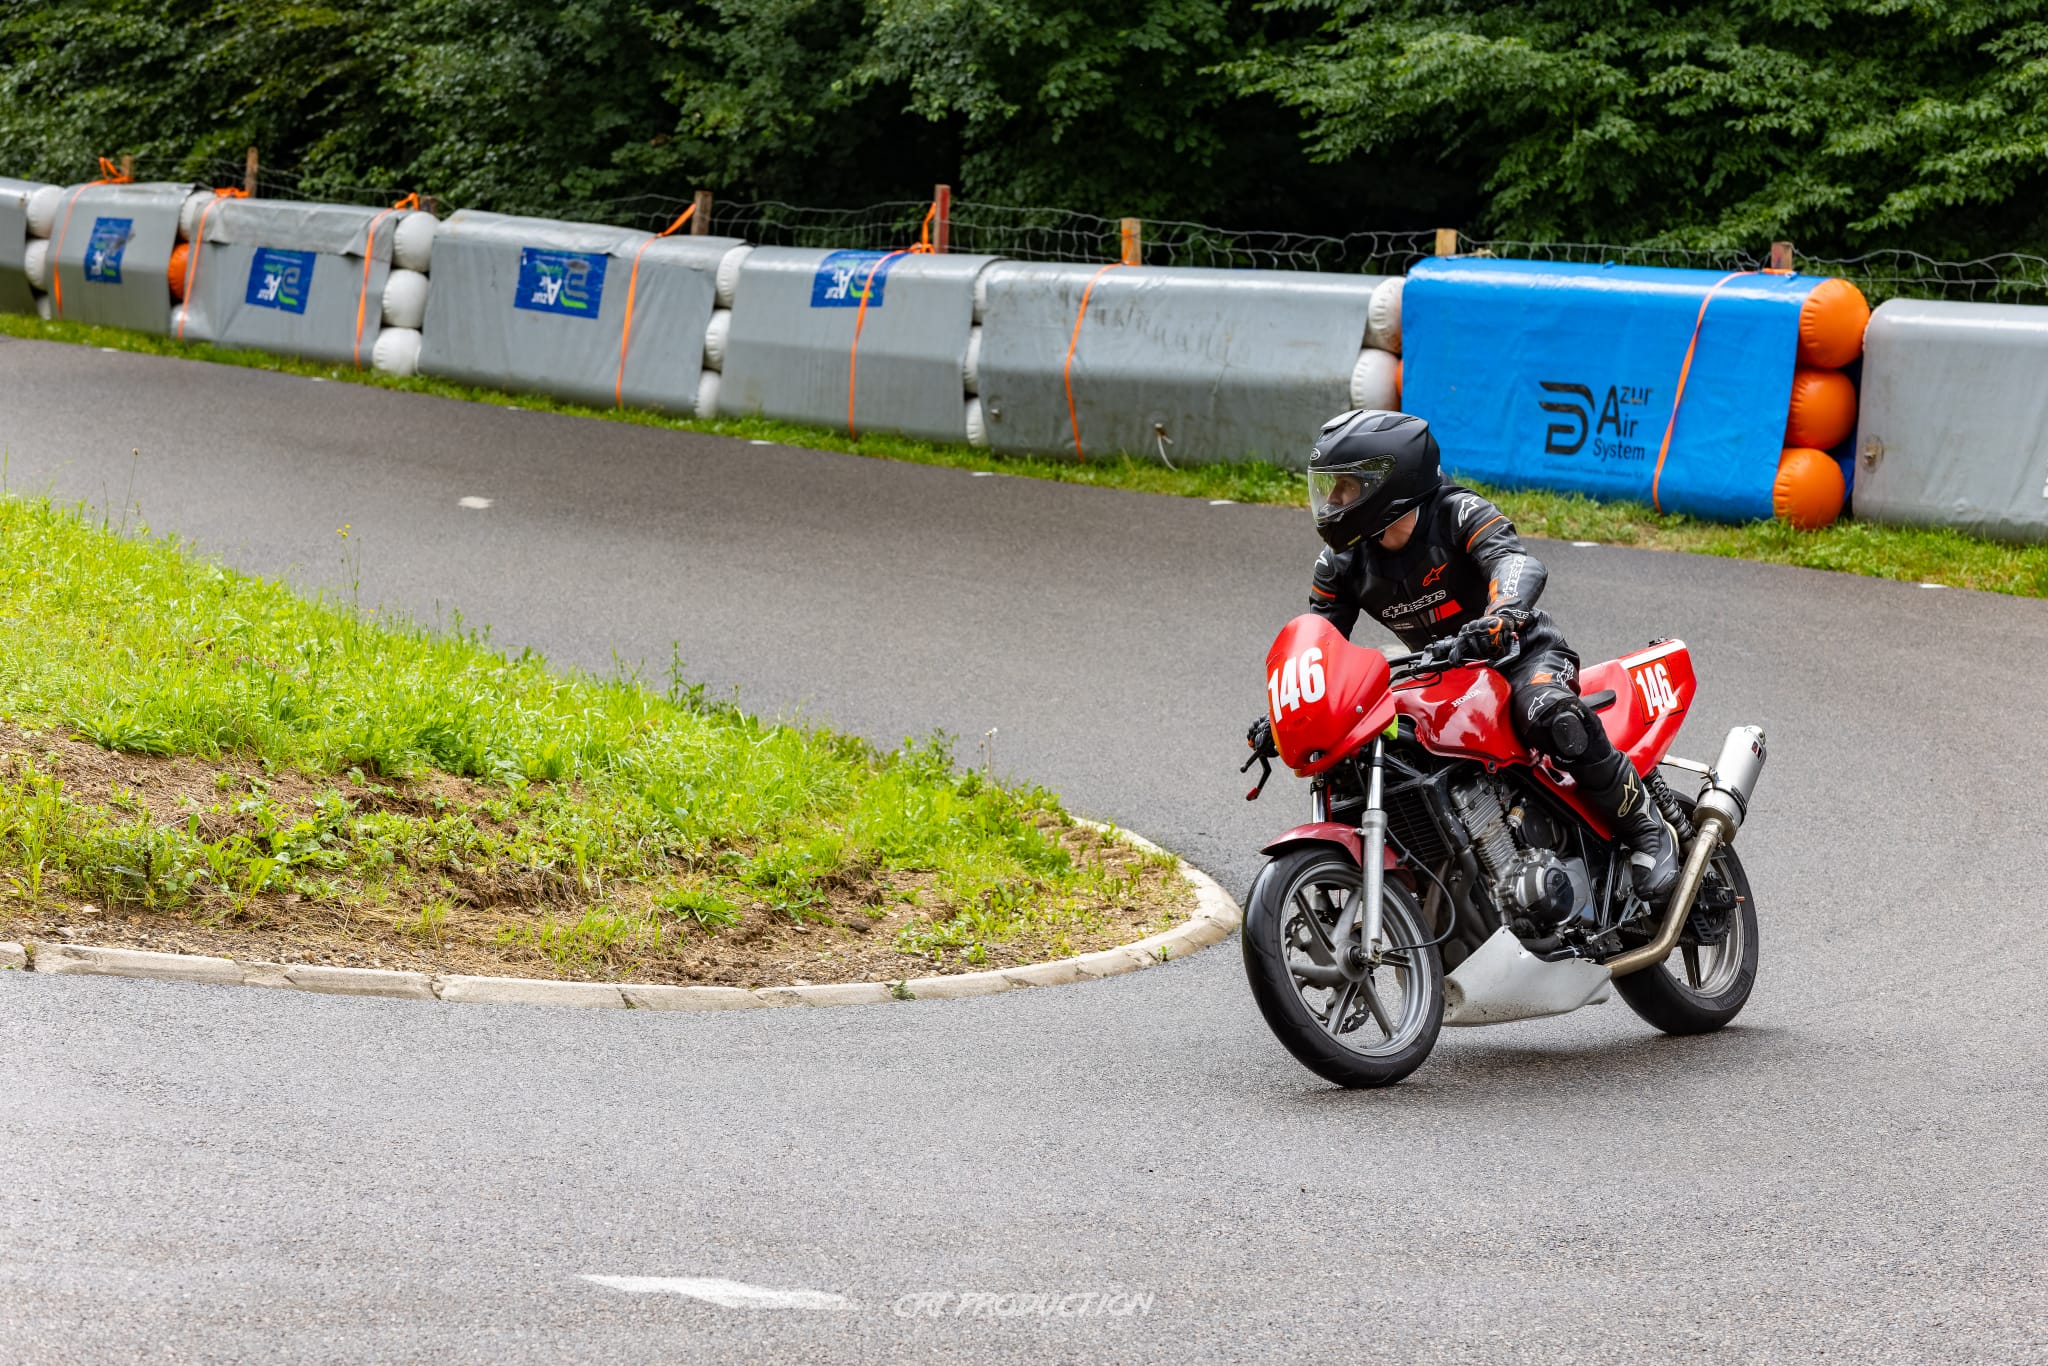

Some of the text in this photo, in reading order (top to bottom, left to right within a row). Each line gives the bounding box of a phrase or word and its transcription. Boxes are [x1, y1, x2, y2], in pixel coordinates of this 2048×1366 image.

[531, 276, 563, 306] Azur
[824, 268, 856, 299] Azur
[1597, 385, 1654, 437] Azur
[1593, 438, 1645, 462] System
[1382, 589, 1447, 618] alpinestars
[1268, 647, 1326, 724] 146
[1635, 663, 1678, 717] 146
